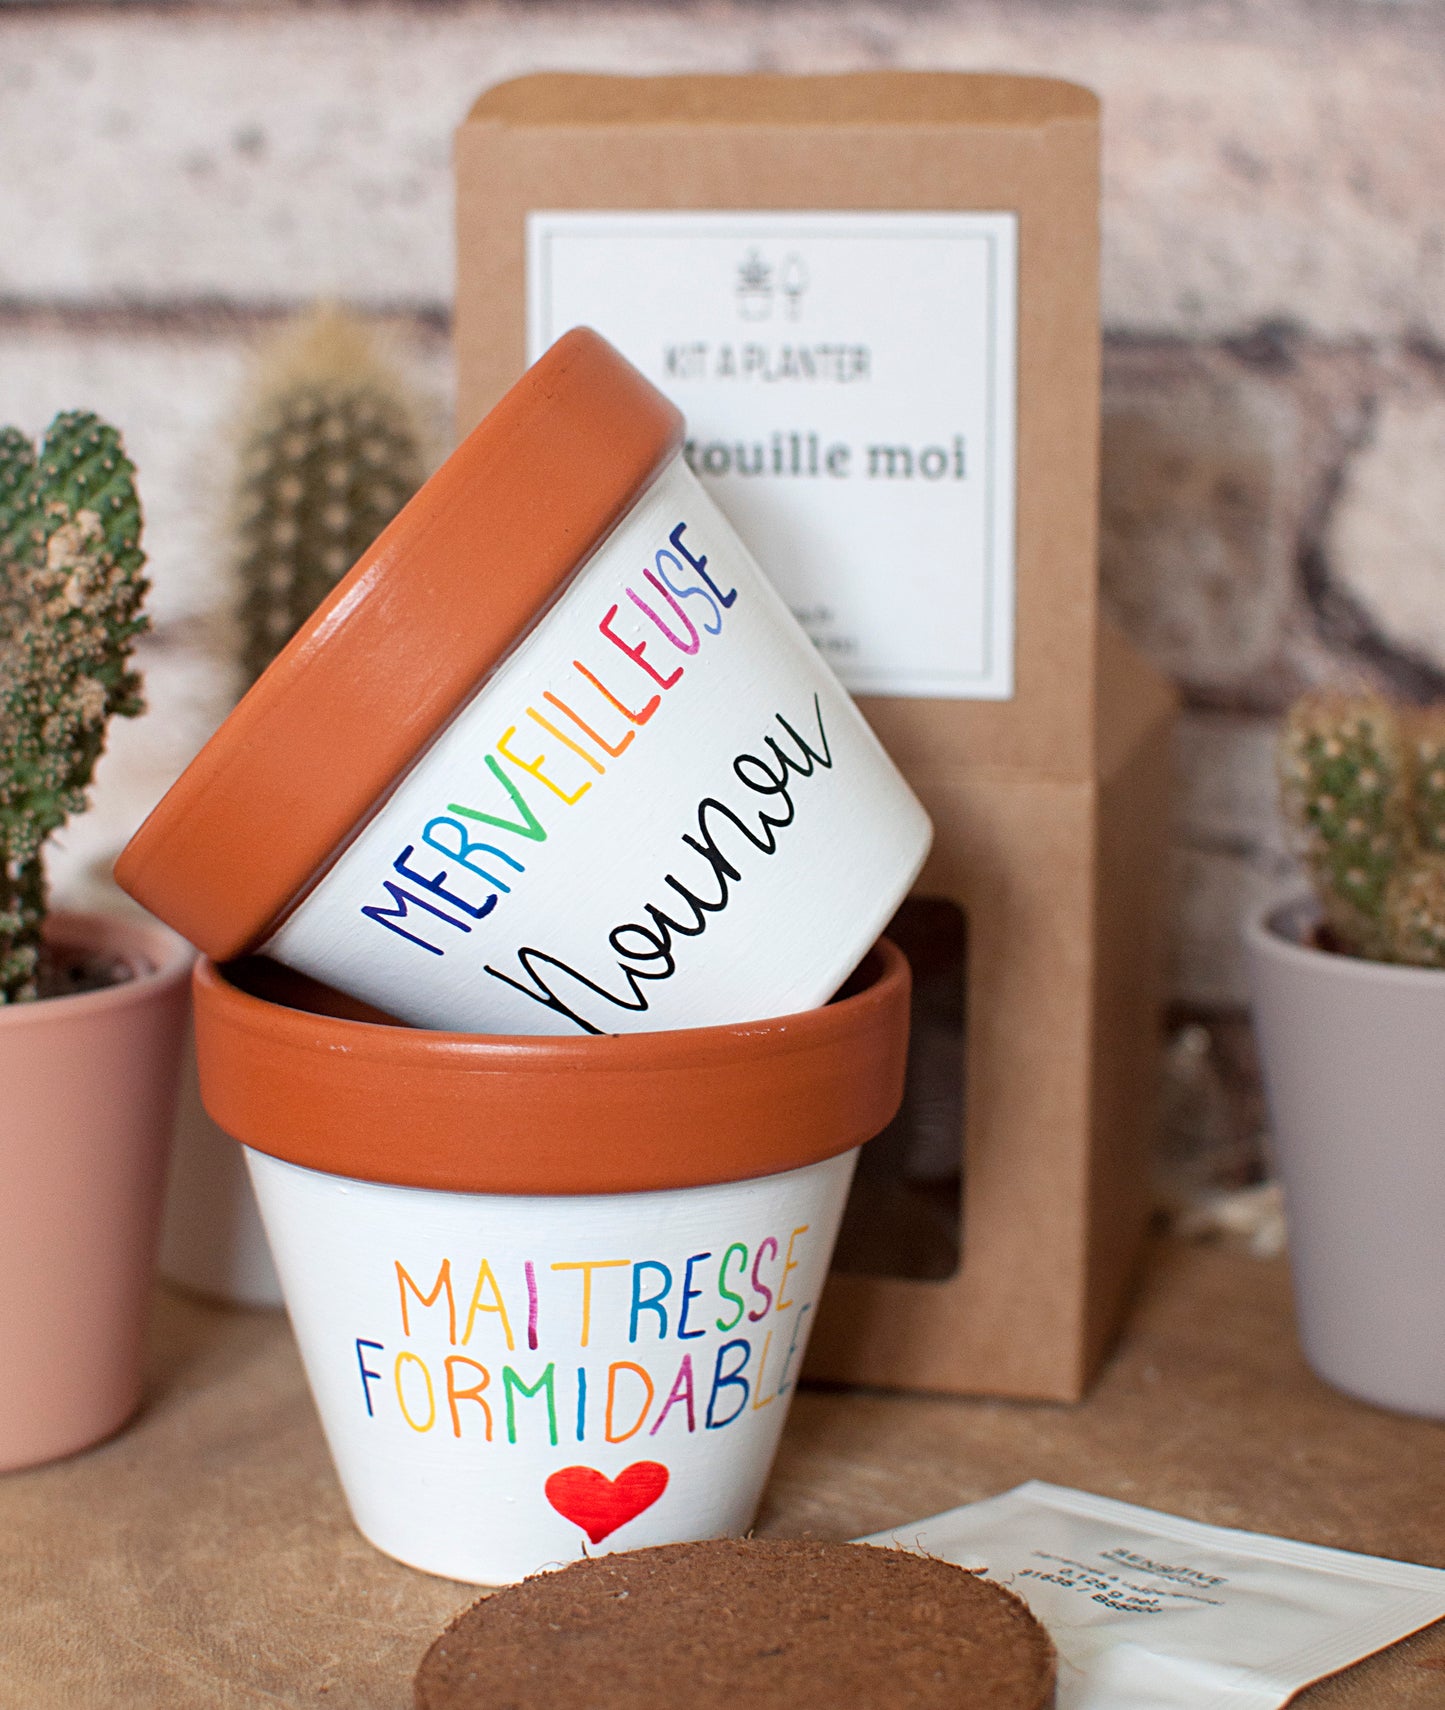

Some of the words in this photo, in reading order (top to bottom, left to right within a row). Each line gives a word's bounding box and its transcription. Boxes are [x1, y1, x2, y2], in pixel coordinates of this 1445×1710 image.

[664, 341, 706, 379] KIT
[741, 342, 871, 383] PLANTER
[683, 431, 849, 477] touille
[866, 433, 966, 480] moi
[361, 522, 738, 956] MERVEILLEUSE
[395, 1225, 809, 1351] MAITRESSE
[356, 1303, 811, 1446] FORMIDABLE
